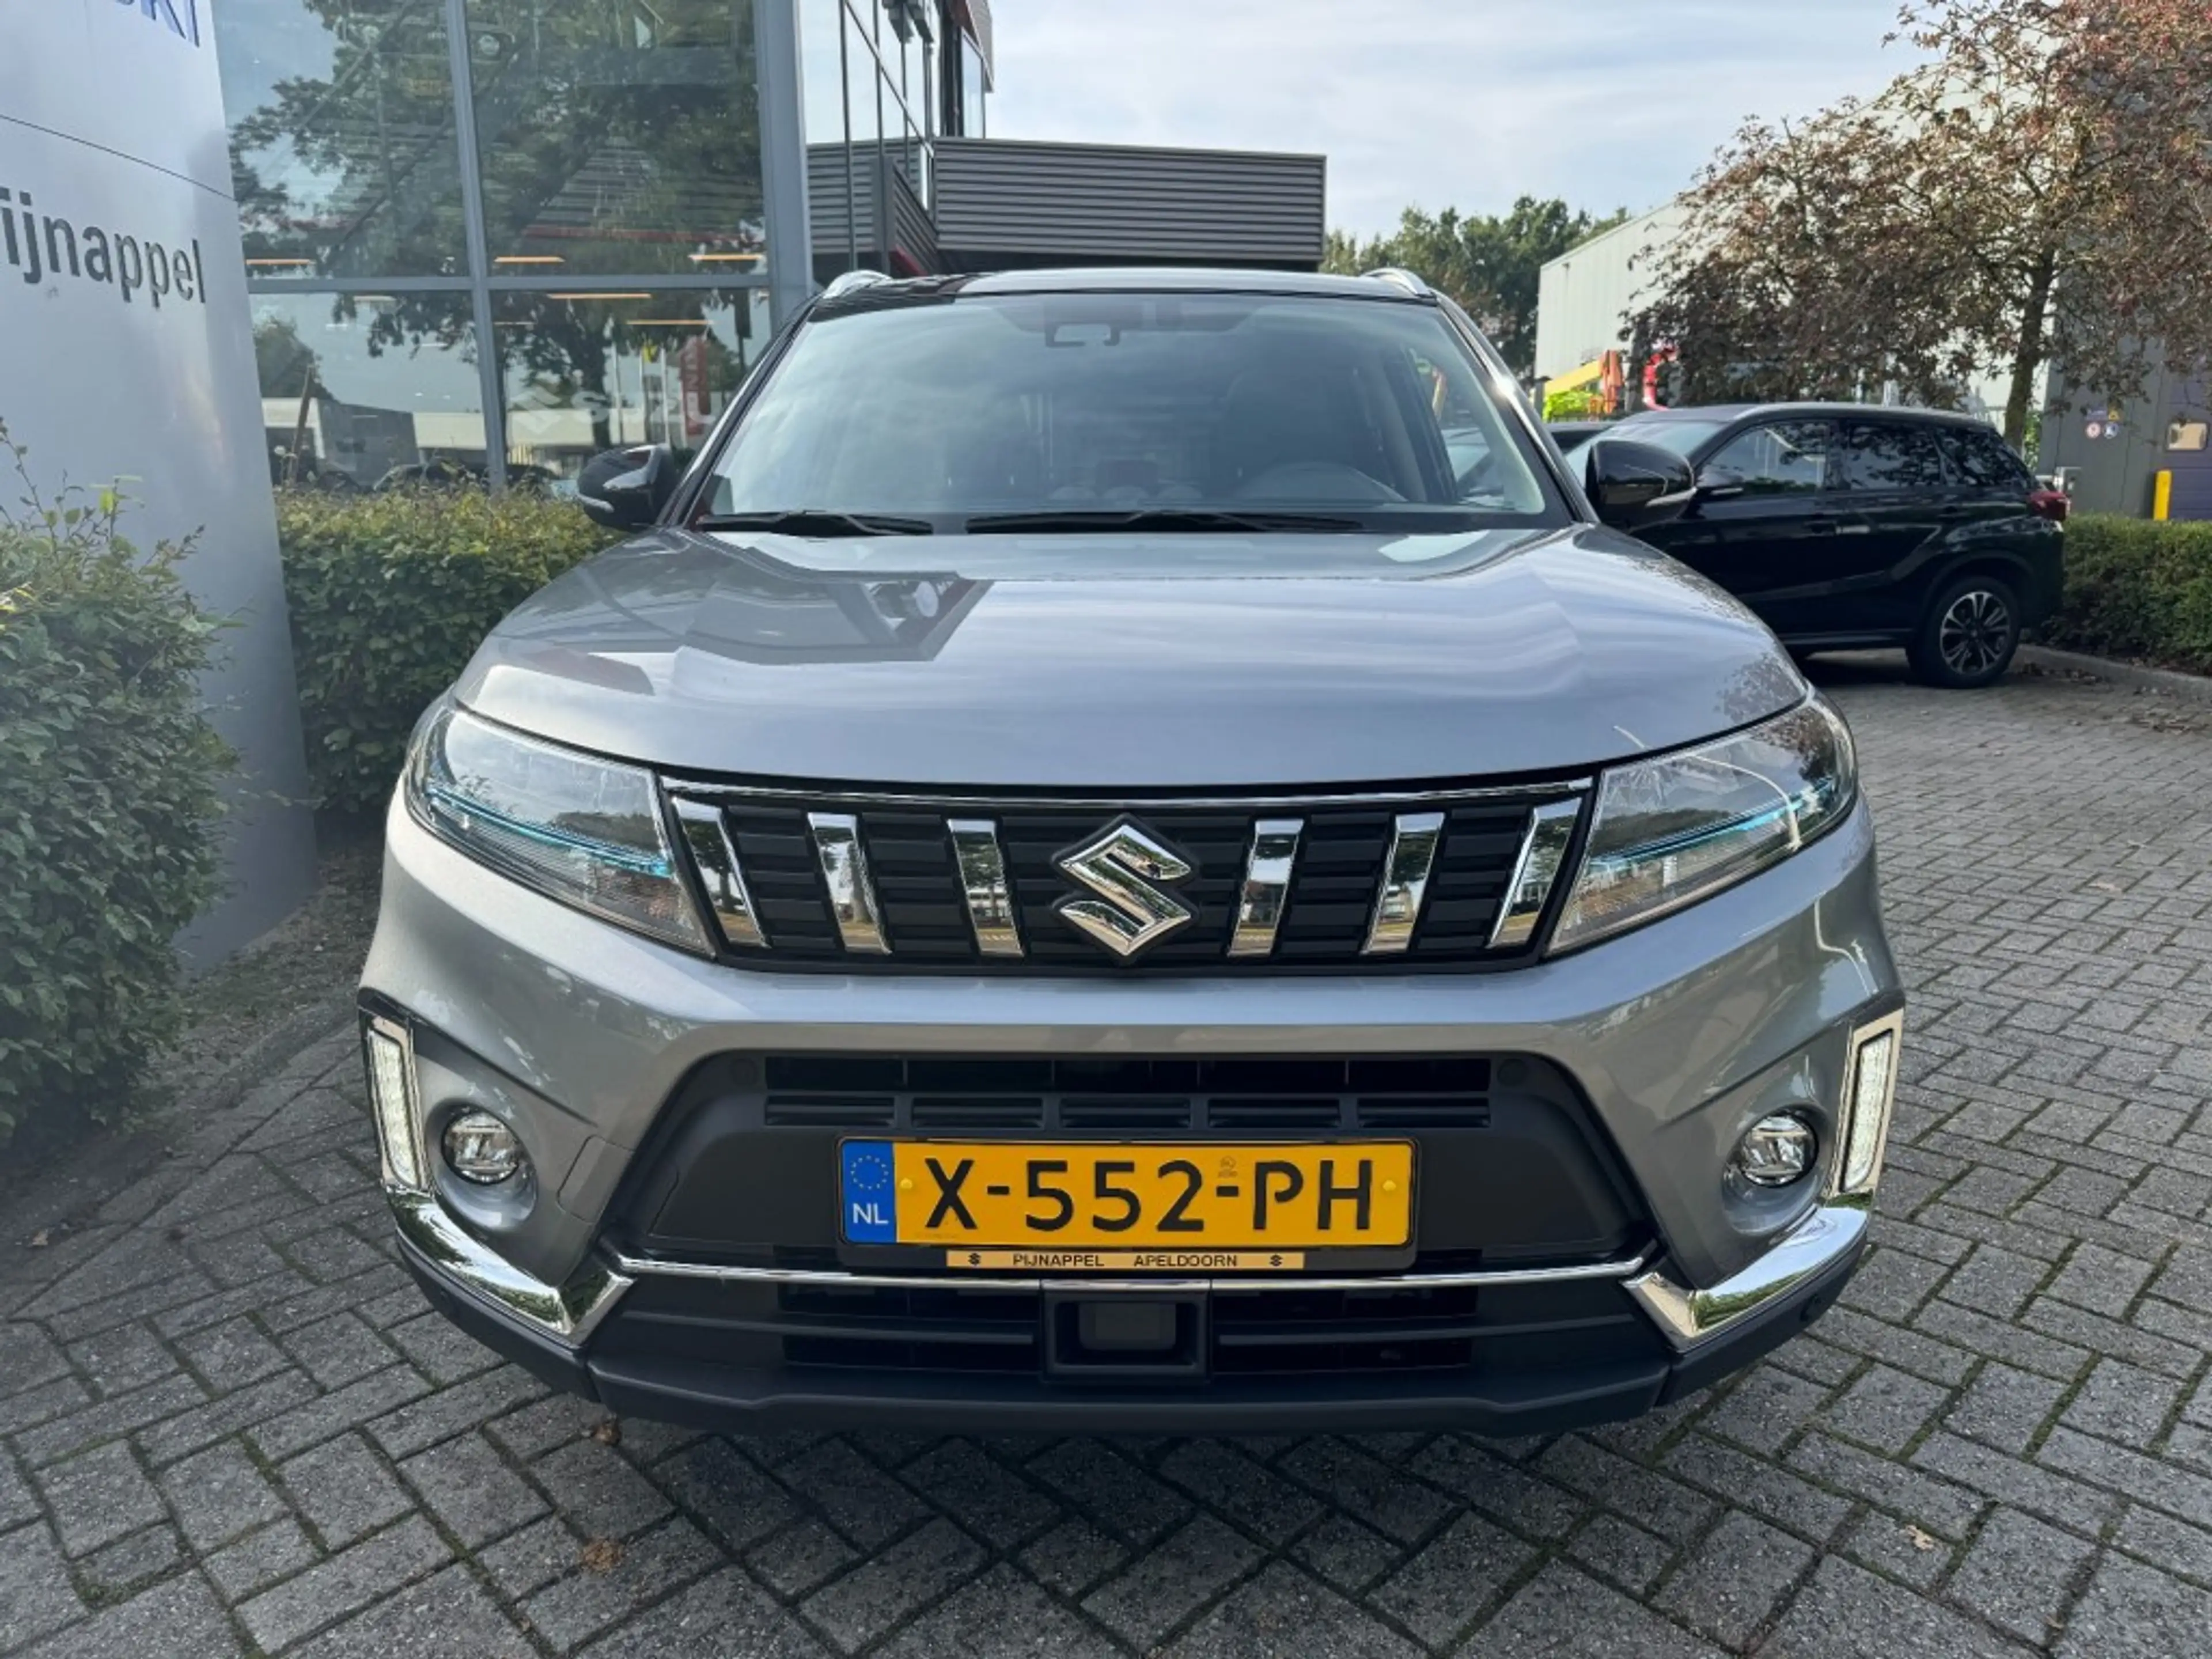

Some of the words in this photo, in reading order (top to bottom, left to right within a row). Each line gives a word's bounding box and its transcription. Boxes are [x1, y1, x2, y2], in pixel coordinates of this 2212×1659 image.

[925, 1157, 1373, 1232] X-552-PH
[853, 1202, 889, 1225] NL
[1013, 1253, 1104, 1267] PIJNAPPEL
[1134, 1255, 1237, 1267] APELDOORN
